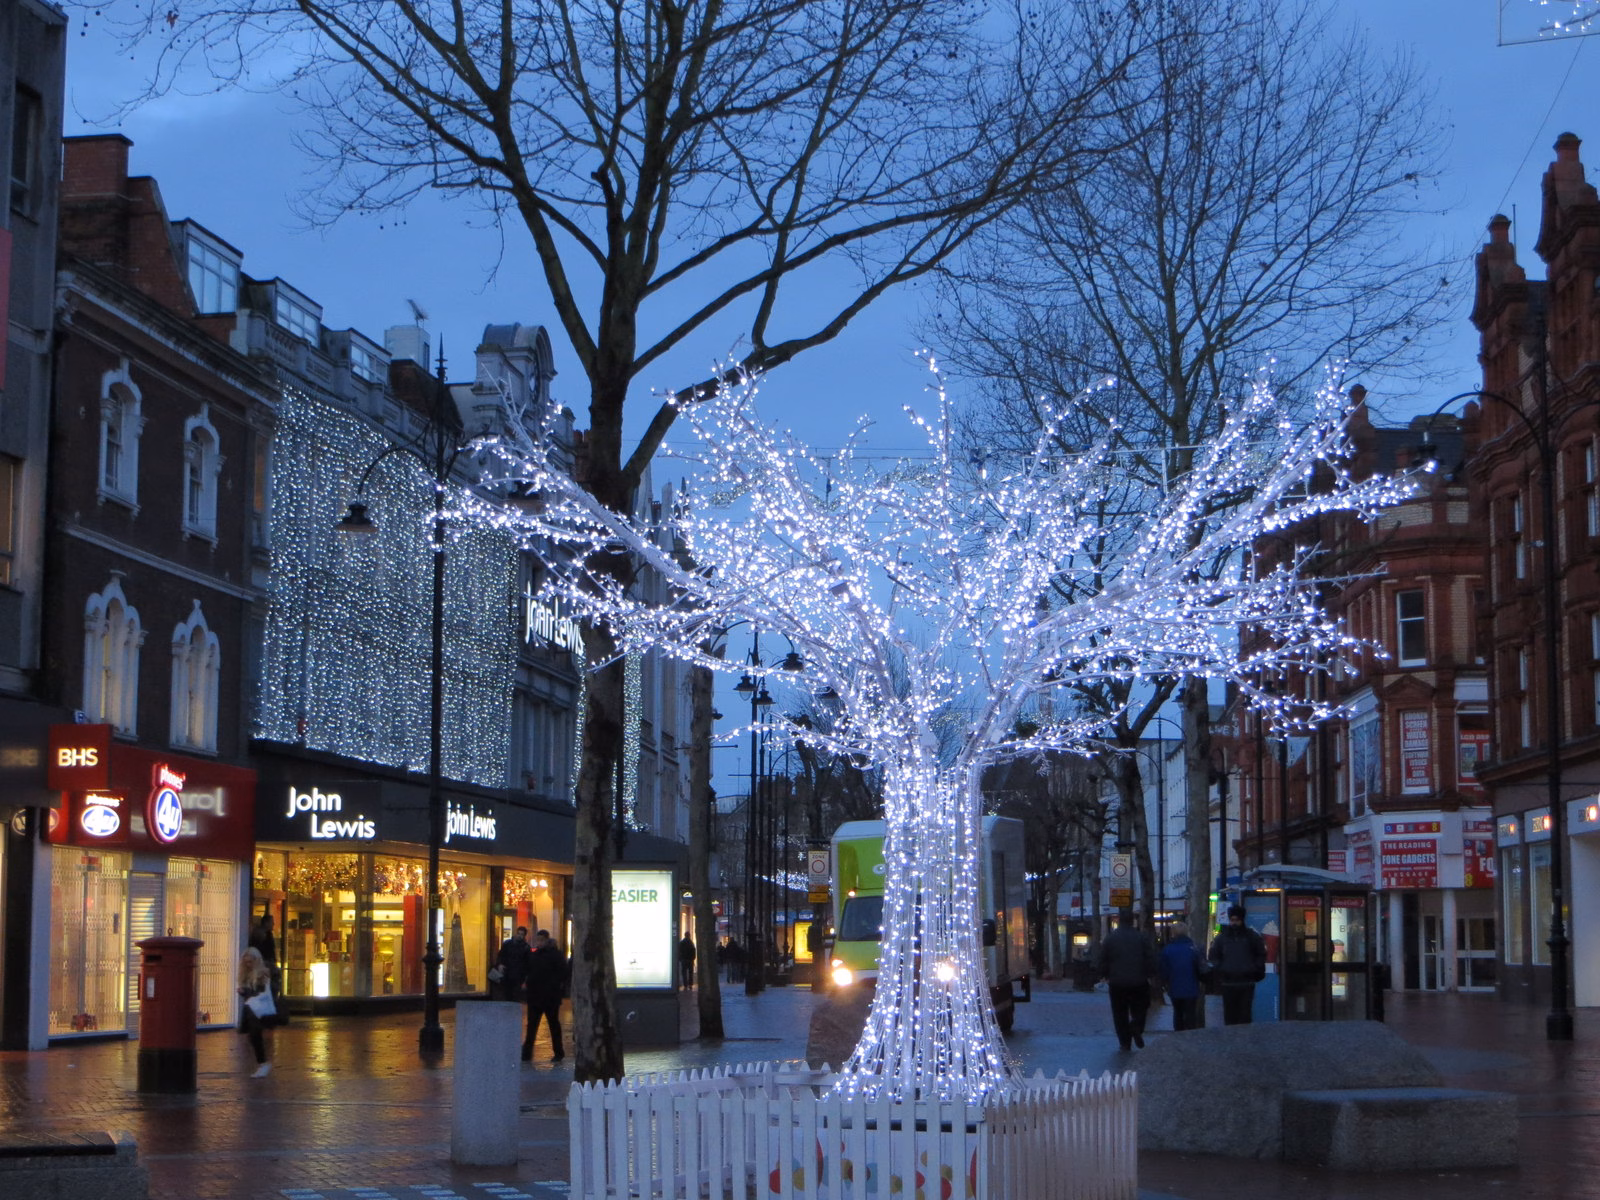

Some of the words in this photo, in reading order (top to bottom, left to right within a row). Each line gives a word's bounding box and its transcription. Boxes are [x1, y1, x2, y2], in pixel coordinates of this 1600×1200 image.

[524, 581, 553, 644] John
[554, 596, 585, 656] Lewis
[58, 748, 98, 767] BHS
[286, 786, 342, 818] John
[311, 813, 376, 839] Lewis
[444, 800, 469, 843] John
[470, 804, 496, 840] Lewis
[1398, 841, 1432, 849] READING
[1382, 855, 1401, 865] FONE
[1401, 853, 1436, 864] GADGETS
[611, 889, 658, 902] EASIER
